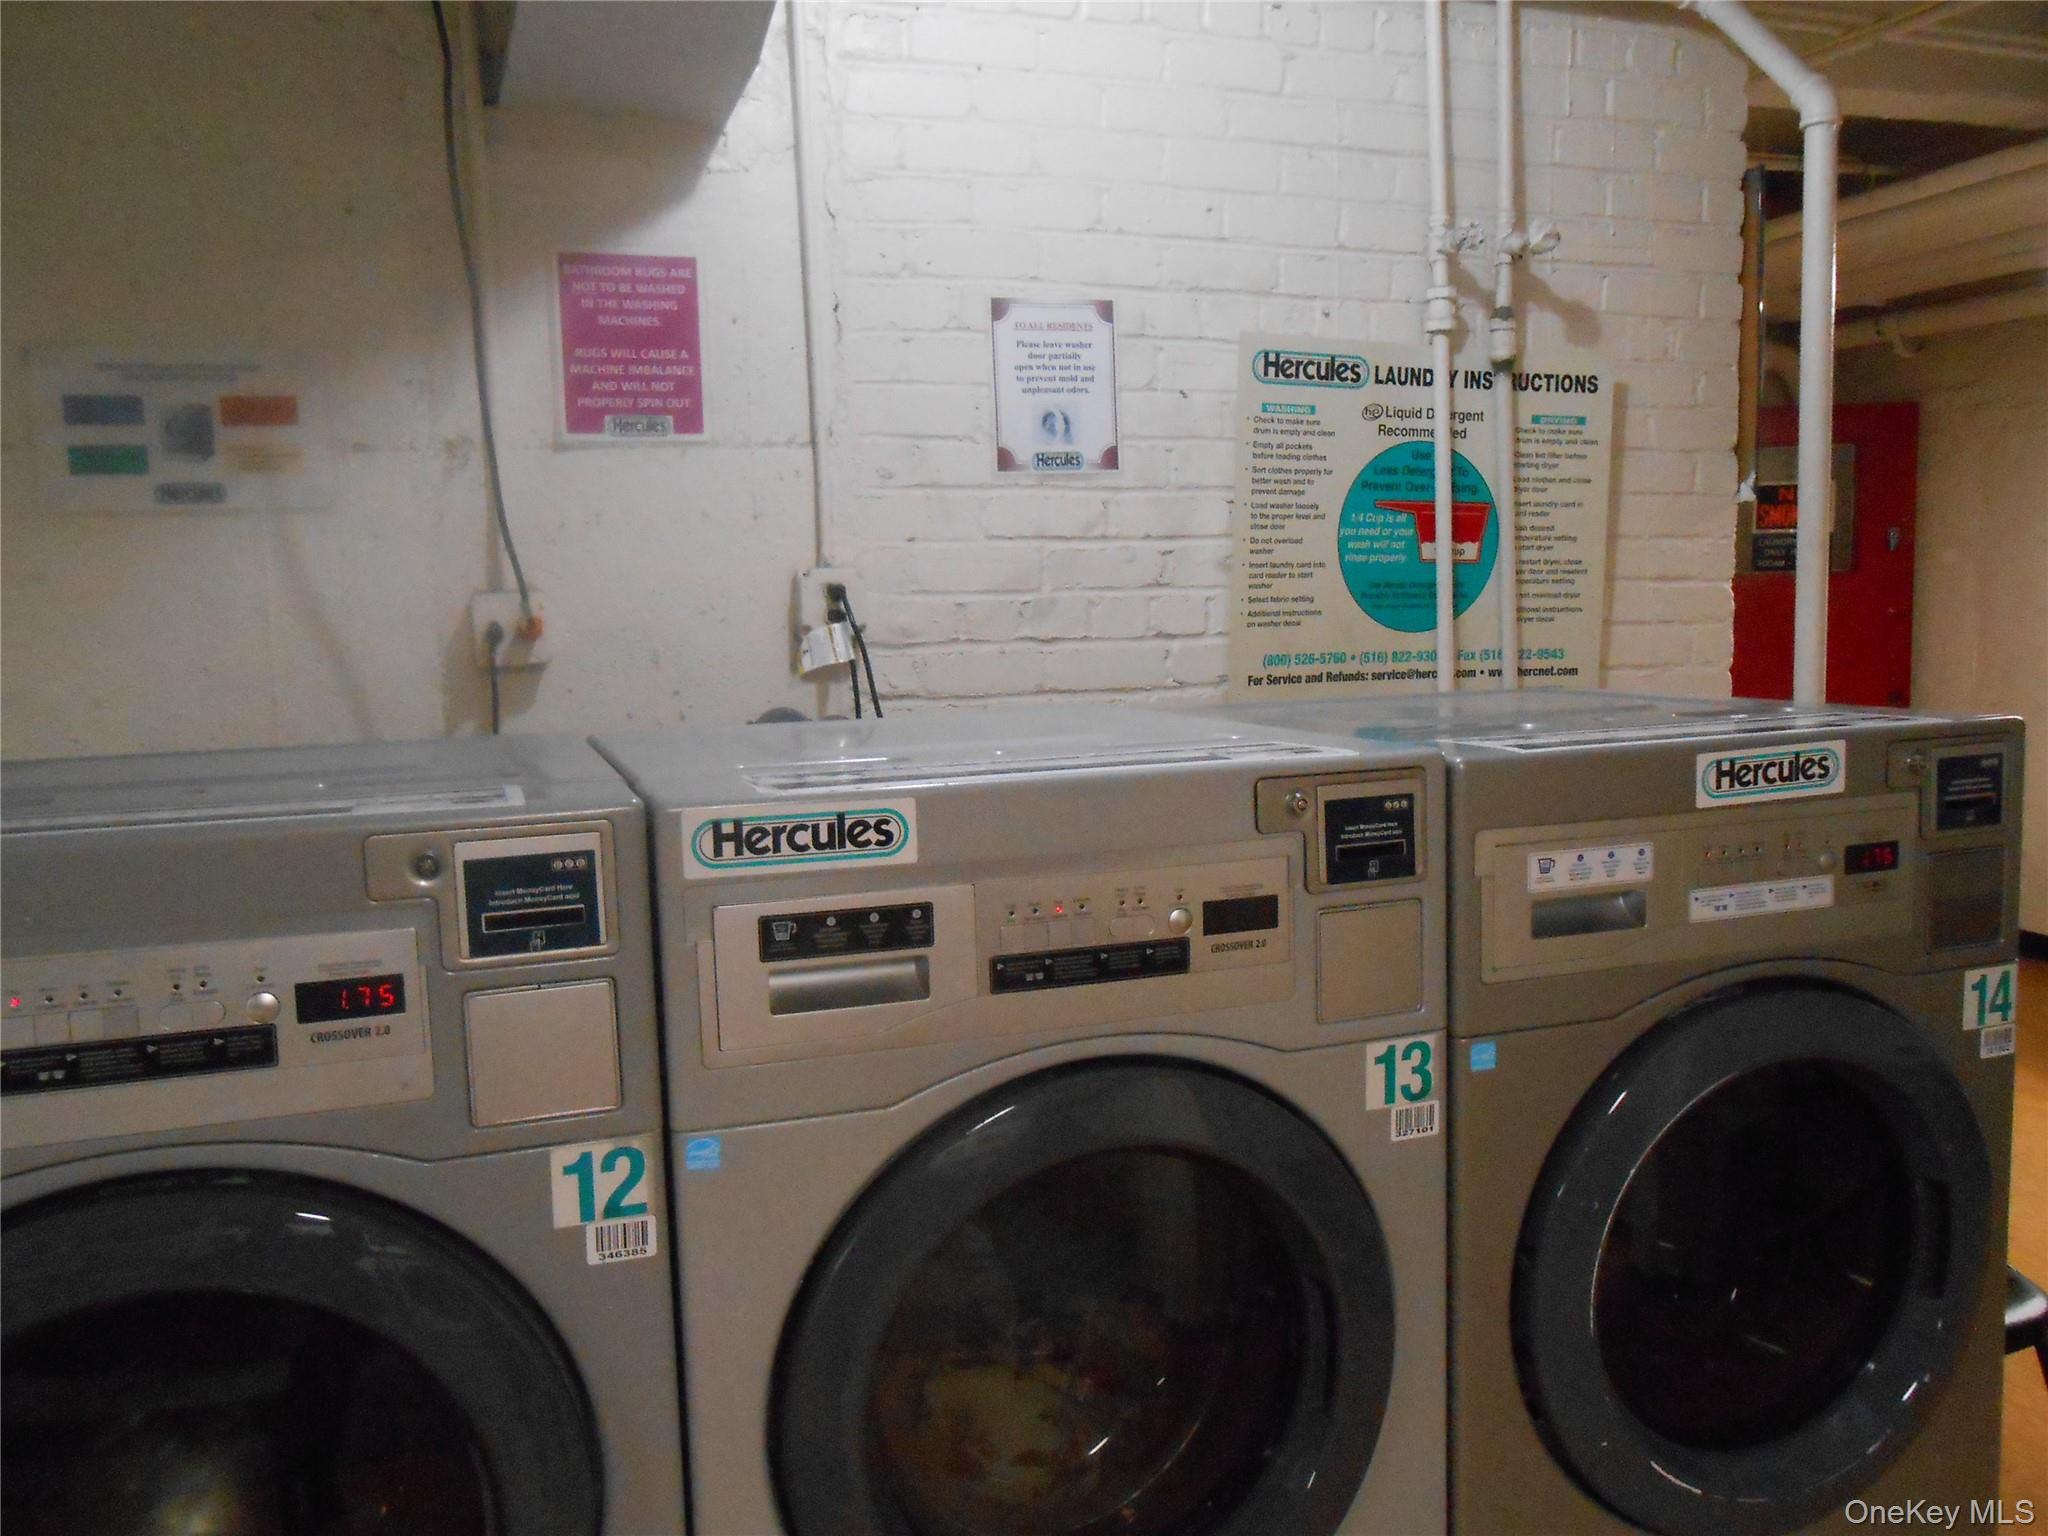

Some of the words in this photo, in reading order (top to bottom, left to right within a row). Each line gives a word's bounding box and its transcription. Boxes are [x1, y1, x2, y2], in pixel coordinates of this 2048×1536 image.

[669, 267, 692, 279] ARE
[573, 281, 596, 293] NOT
[599, 281, 616, 293] TO
[619, 282, 633, 294] BE
[636, 283, 686, 295] WASHED
[581, 298, 594, 309] IN
[598, 299, 618, 309] THE
[622, 299, 678, 311] WASHING
[1015, 321, 1027, 330] TO
[1028, 321, 1045, 330] ALL
[1047, 322, 1093, 330] RESIDENTS
[1016, 340, 1040, 349] Please
[1043, 341, 1063, 349] leave
[1065, 341, 1092, 349] washer
[575, 348, 608, 358] RUGS
[611, 348, 638, 359] WILL
[640, 349, 677, 359] CAUSE
[680, 350, 689, 359] A
[1027, 352, 1046, 360] door
[1048, 351, 1082, 362] partially
[570, 364, 625, 375] MACHINE
[628, 365, 696, 376] IMBALANCE
[1014, 364, 1034, 372] open
[1035, 363, 1056, 371] when
[1059, 363, 1072, 371] not
[1073, 363, 1081, 371] in
[1083, 364, 1096, 372] use
[1263, 351, 1362, 384] Hercules
[1016, 374, 1025, 382] to
[1026, 375, 1056, 384] prevent
[1058, 374, 1078, 382] mold
[1080, 374, 1095, 382] and
[1374, 365, 1459, 388] LAUNDY
[592, 381, 617, 391] AND
[621, 381, 649, 391] WILL
[651, 382, 675, 391] NOT
[1021, 386, 1064, 395] unpleasant
[1066, 386, 1090, 394] odors.
[577, 398, 634, 408] PROPERLY
[637, 398, 662, 408] SPIN
[1386, 406, 1422, 421] Liquid
[613, 417, 667, 433] Hercules
[1253, 415, 1274, 424] Check
[1279, 429, 1300, 437] empty
[1378, 424, 1467, 439] Recommeed
[1252, 441, 1274, 450] Empty
[1285, 442, 1313, 450] pockets
[1035, 452, 1082, 468] Hercules
[1275, 453, 1301, 462] loading
[1412, 450, 1432, 461] Use
[1294, 468, 1322, 476] properly
[1374, 465, 1398, 476] Less
[1361, 481, 1401, 491] Prevent
[1251, 488, 1278, 496] prevent
[1278, 488, 1306, 496] damage
[1295, 502, 1319, 511] loosely
[1271, 513, 1294, 521] proper
[1366, 513, 1384, 524] Cup
[1385, 513, 1394, 523] is
[1396, 513, 1408, 523] all
[1339, 528, 1356, 538] you
[1358, 527, 1381, 536] need
[1382, 528, 1393, 536] or
[1394, 528, 1414, 538] your
[1249, 537, 1259, 545] Do
[1261, 537, 1273, 545] not
[1273, 537, 1304, 545] overload
[1347, 541, 1371, 549] wash
[1373, 541, 1390, 549] will
[1390, 541, 1406, 549] not
[1249, 547, 1274, 555] washer
[1345, 554, 1365, 562] rinse
[1368, 554, 1407, 564] properly
[1269, 562, 1295, 570] laundry
[1257, 620, 1281, 628] washer
[1263, 654, 1292, 669] (800)
[1294, 652, 1347, 665] 526-5760
[1359, 651, 1388, 665] (516)
[1458, 649, 1477, 661] Fax
[1247, 675, 1263, 687] For
[1266, 673, 1300, 686] Service
[1305, 673, 1323, 684] and
[1326, 670, 1369, 683] Refunds:
[1715, 751, 1831, 790] Hercules
[711, 812, 894, 858] Hercules
[1210, 941, 1253, 954] CROSSOVER
[1255, 940, 1267, 949] 2.0
[1971, 970, 2012, 1026] 14
[310, 1027, 372, 1043] CROSSOVER
[376, 1025, 391, 1036] 2.0
[1374, 1040, 1433, 1105] 13
[1395, 1126, 1434, 1138] 327101
[562, 1146, 648, 1223] 12
[598, 1248, 648, 1261] 346385
